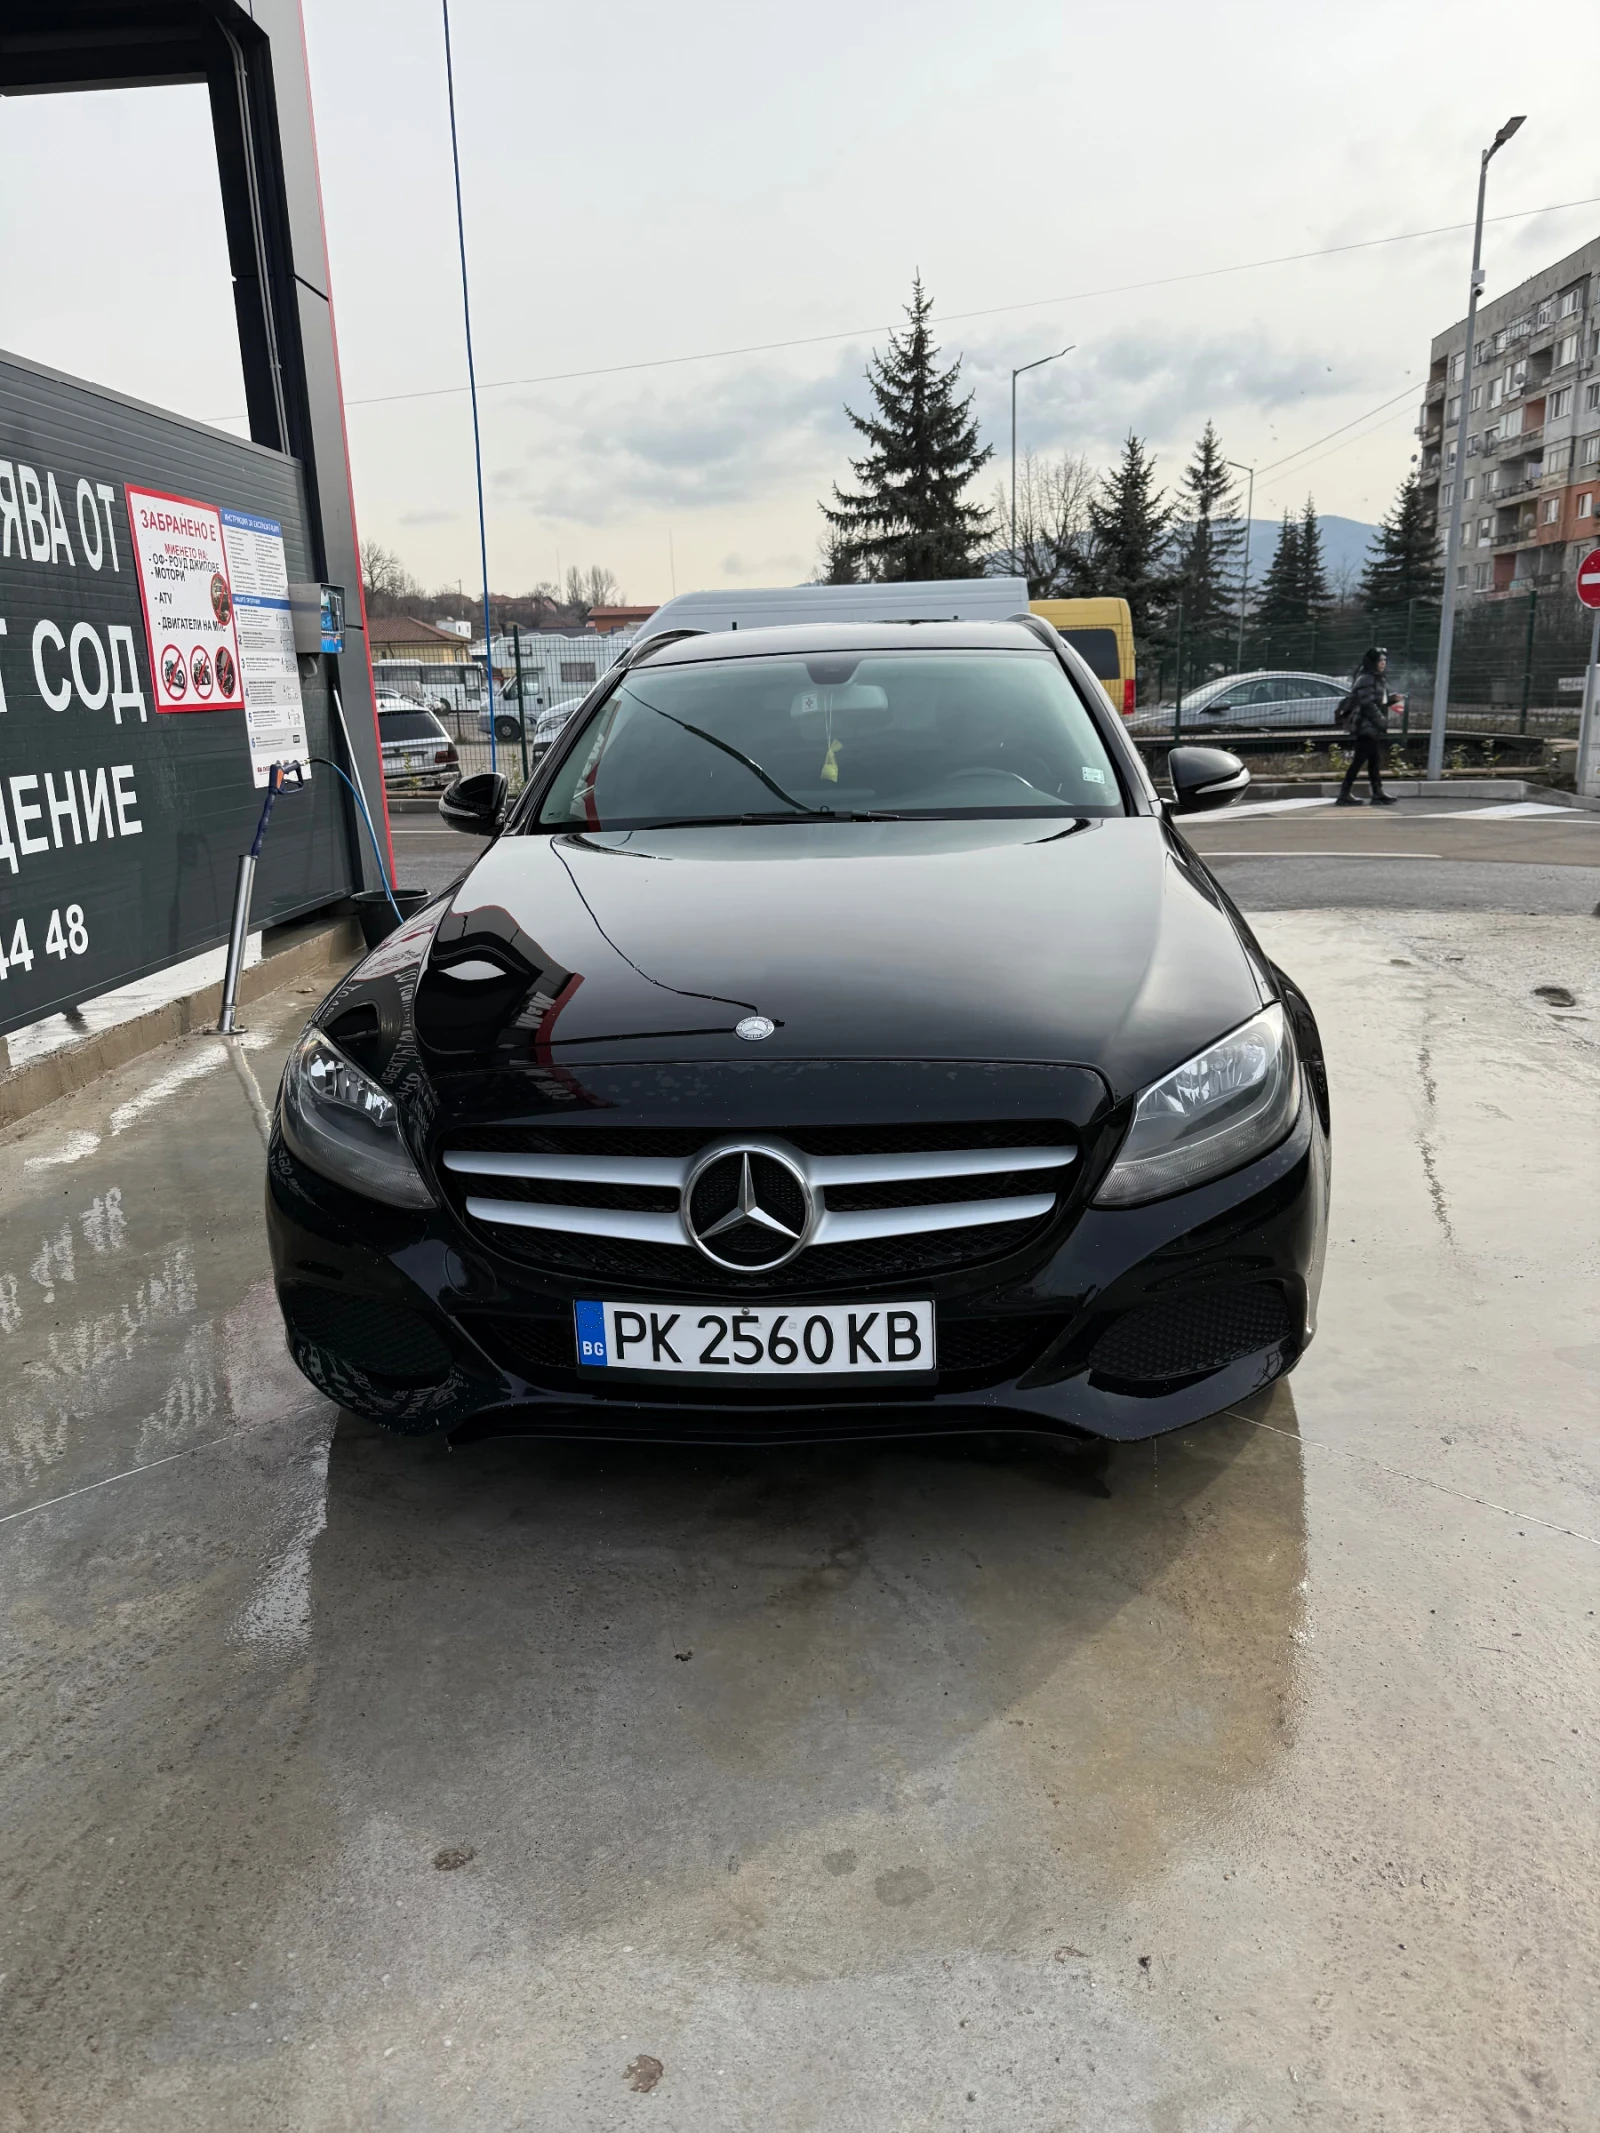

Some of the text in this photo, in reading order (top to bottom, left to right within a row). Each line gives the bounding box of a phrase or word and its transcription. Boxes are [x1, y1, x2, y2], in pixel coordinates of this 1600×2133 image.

[76, 478, 120, 572] ОТ
[140, 508, 217, 541] ЗАБРАНЕНО Е
[164, 543, 197, 559] МИЕНЕТО
[202, 619, 213, 632] НА
[32, 618, 148, 725] СОД
[45, 903, 89, 961] 48
[582, 1340, 604, 1357] BG
[613, 1309, 922, 1366] PK 2560 KB
